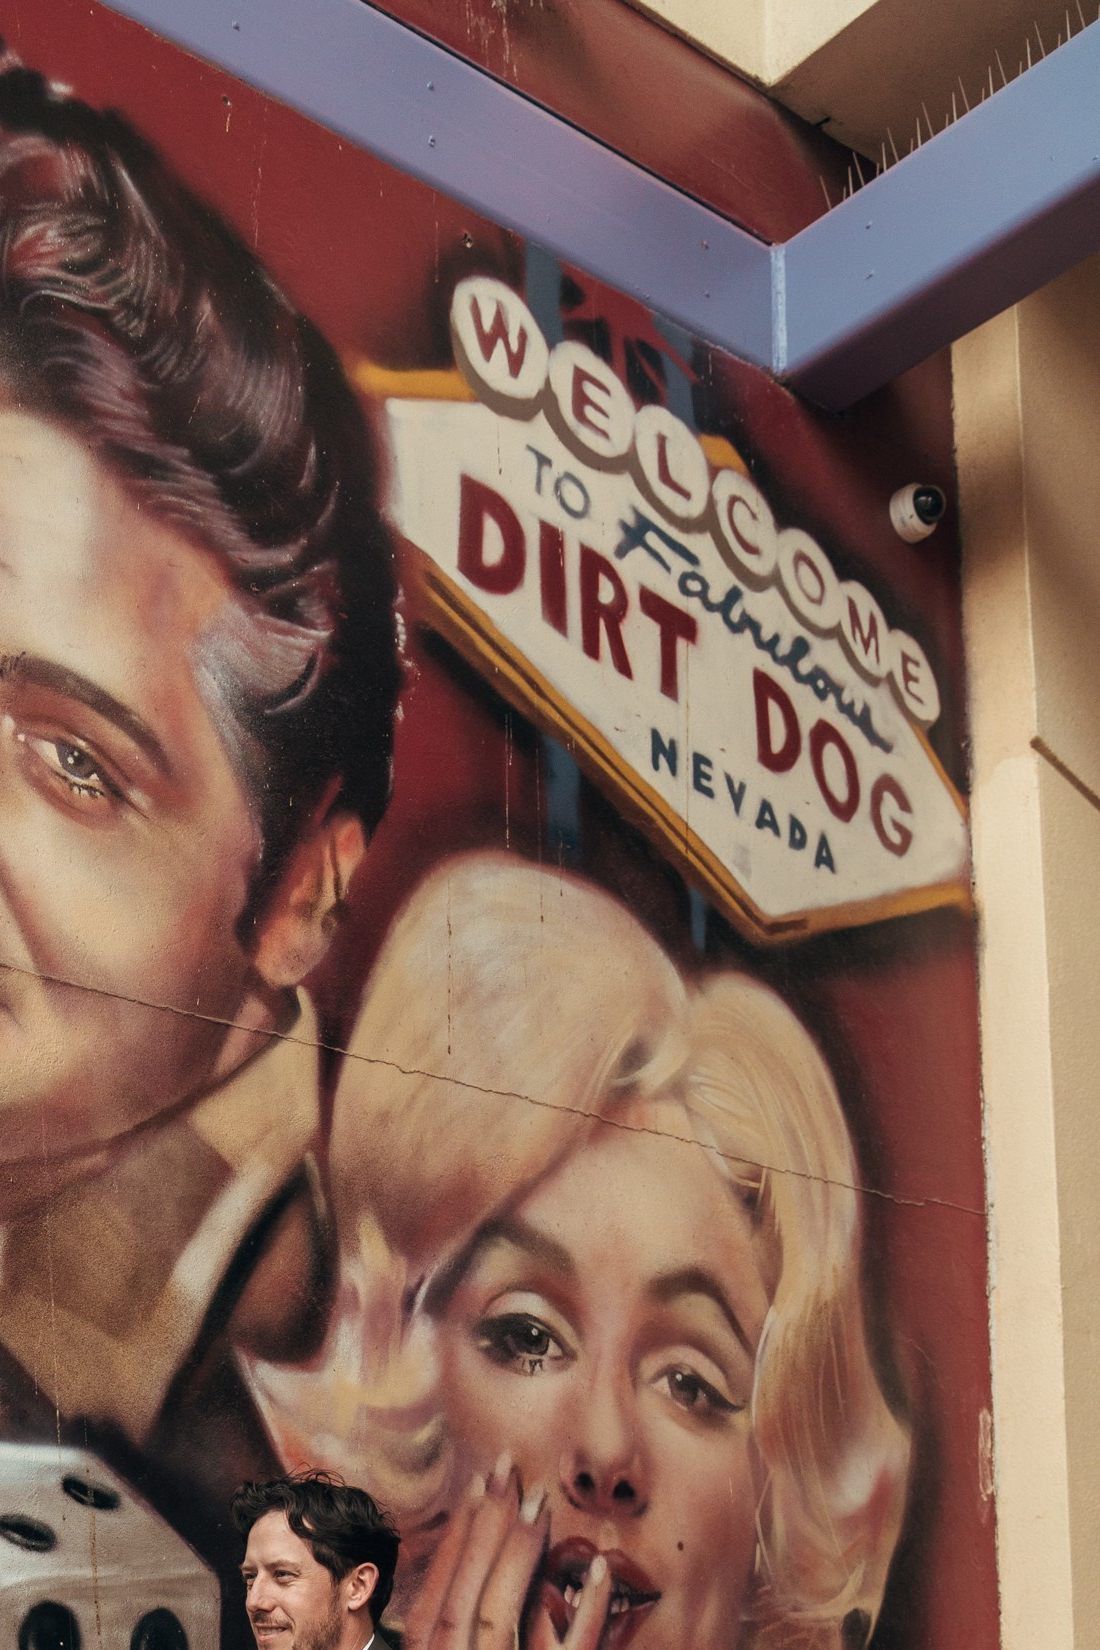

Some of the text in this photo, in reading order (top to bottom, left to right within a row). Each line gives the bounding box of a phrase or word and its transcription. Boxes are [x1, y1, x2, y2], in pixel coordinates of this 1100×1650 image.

[469, 293, 925, 704] WELCOME
[526, 444, 592, 519] TO
[456, 472, 913, 858] DIRT DOG
[651, 727, 837, 874] NEVADA
